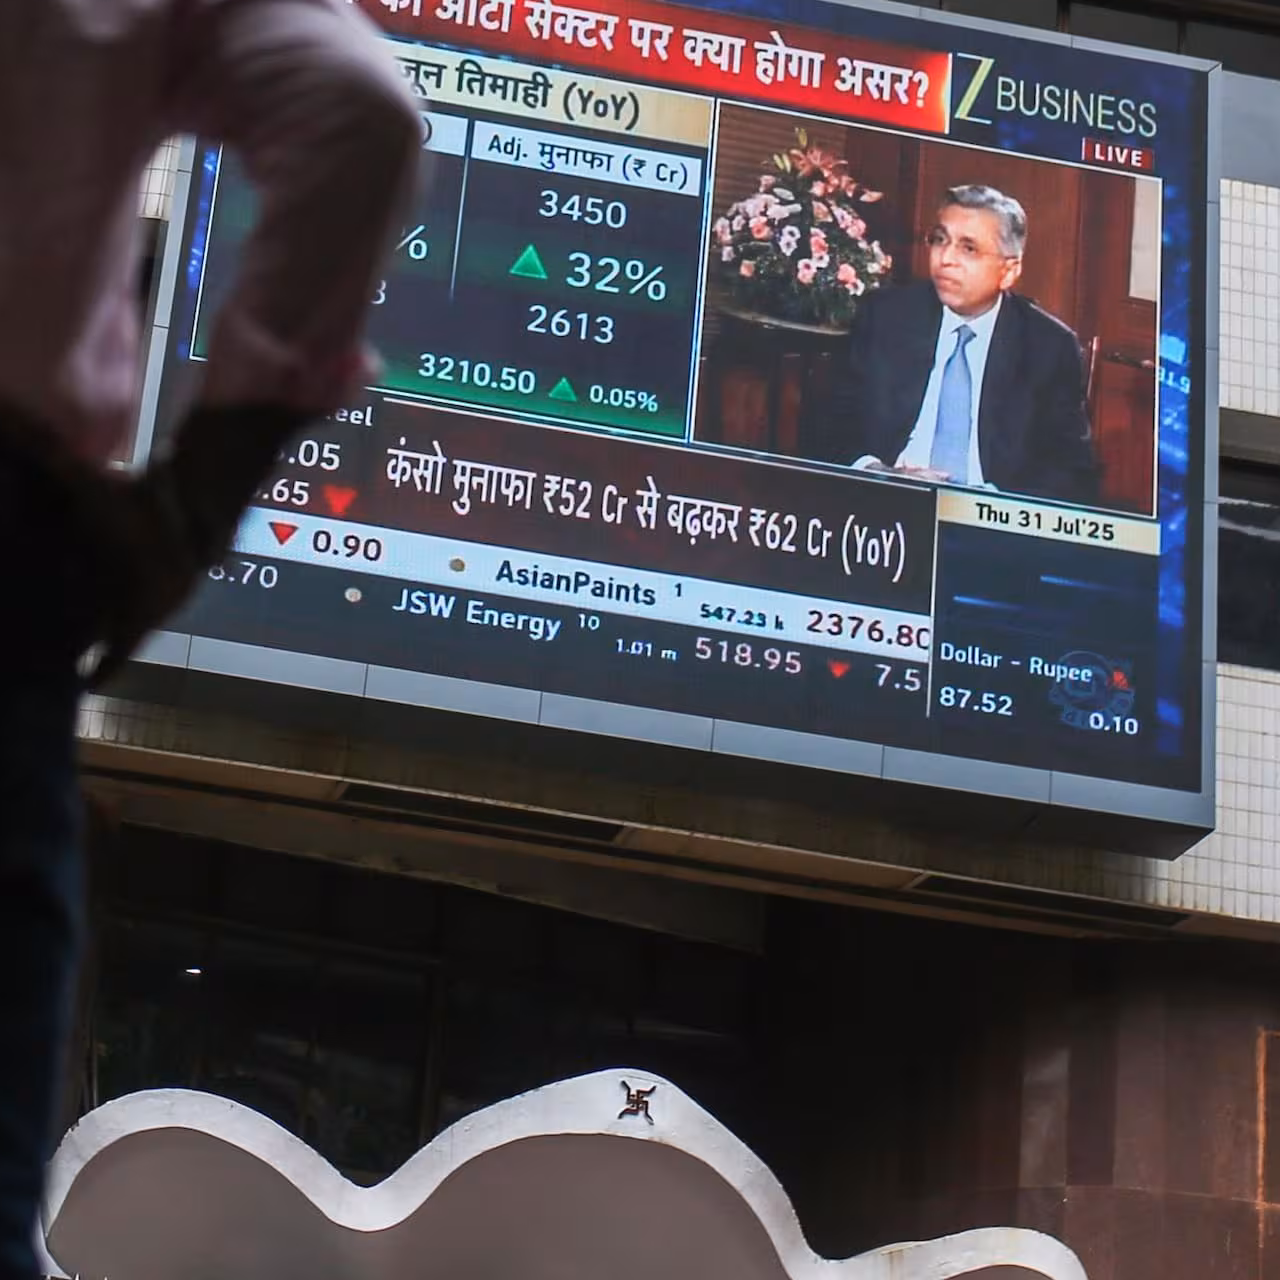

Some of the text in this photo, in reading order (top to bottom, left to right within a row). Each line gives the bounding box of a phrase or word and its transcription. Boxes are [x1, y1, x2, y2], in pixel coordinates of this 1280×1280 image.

[628, 19, 673, 61] पर
[682, 28, 746, 74] क्या
[754, 30, 825, 88] होगा
[834, 56, 930, 107] असर?
[455, 58, 553, 109] तिमाही
[563, 81, 640, 131] (YoY)
[997, 77, 1157, 137] BUSINESS
[487, 134, 528, 161] Adj.
[538, 142, 614, 171] मुनाफा
[1094, 142, 1143, 167] LIVE
[538, 189, 628, 229] 3450
[565, 251, 667, 301] 32%
[526, 304, 614, 344] 2613
[418, 353, 659, 412] 3210.50 0.05%
[386, 436, 446, 495] कंसो
[452, 458, 537, 515] मुनाफा
[601, 484, 628, 525] Cr
[635, 475, 662, 530] से
[667, 493, 742, 546] बढ़कर
[807, 518, 832, 558] Cr
[841, 514, 906, 583] (YoY)
[975, 502, 1115, 541] Thu 31 Jul'25
[312, 529, 382, 562] 0.90
[495, 559, 656, 606] AsianPaints
[807, 610, 931, 650] 2376.80
[392, 587, 455, 618] JSW
[466, 600, 561, 641] Energy
[578, 614, 600, 631] 10
[695, 637, 802, 674] 518.95
[874, 664, 921, 692] 7.5
[940, 643, 1003, 669] Dollar
[1029, 657, 1093, 683] Rupee
[939, 687, 1013, 717] 87.52
[1088, 712, 1138, 735] 0.10
